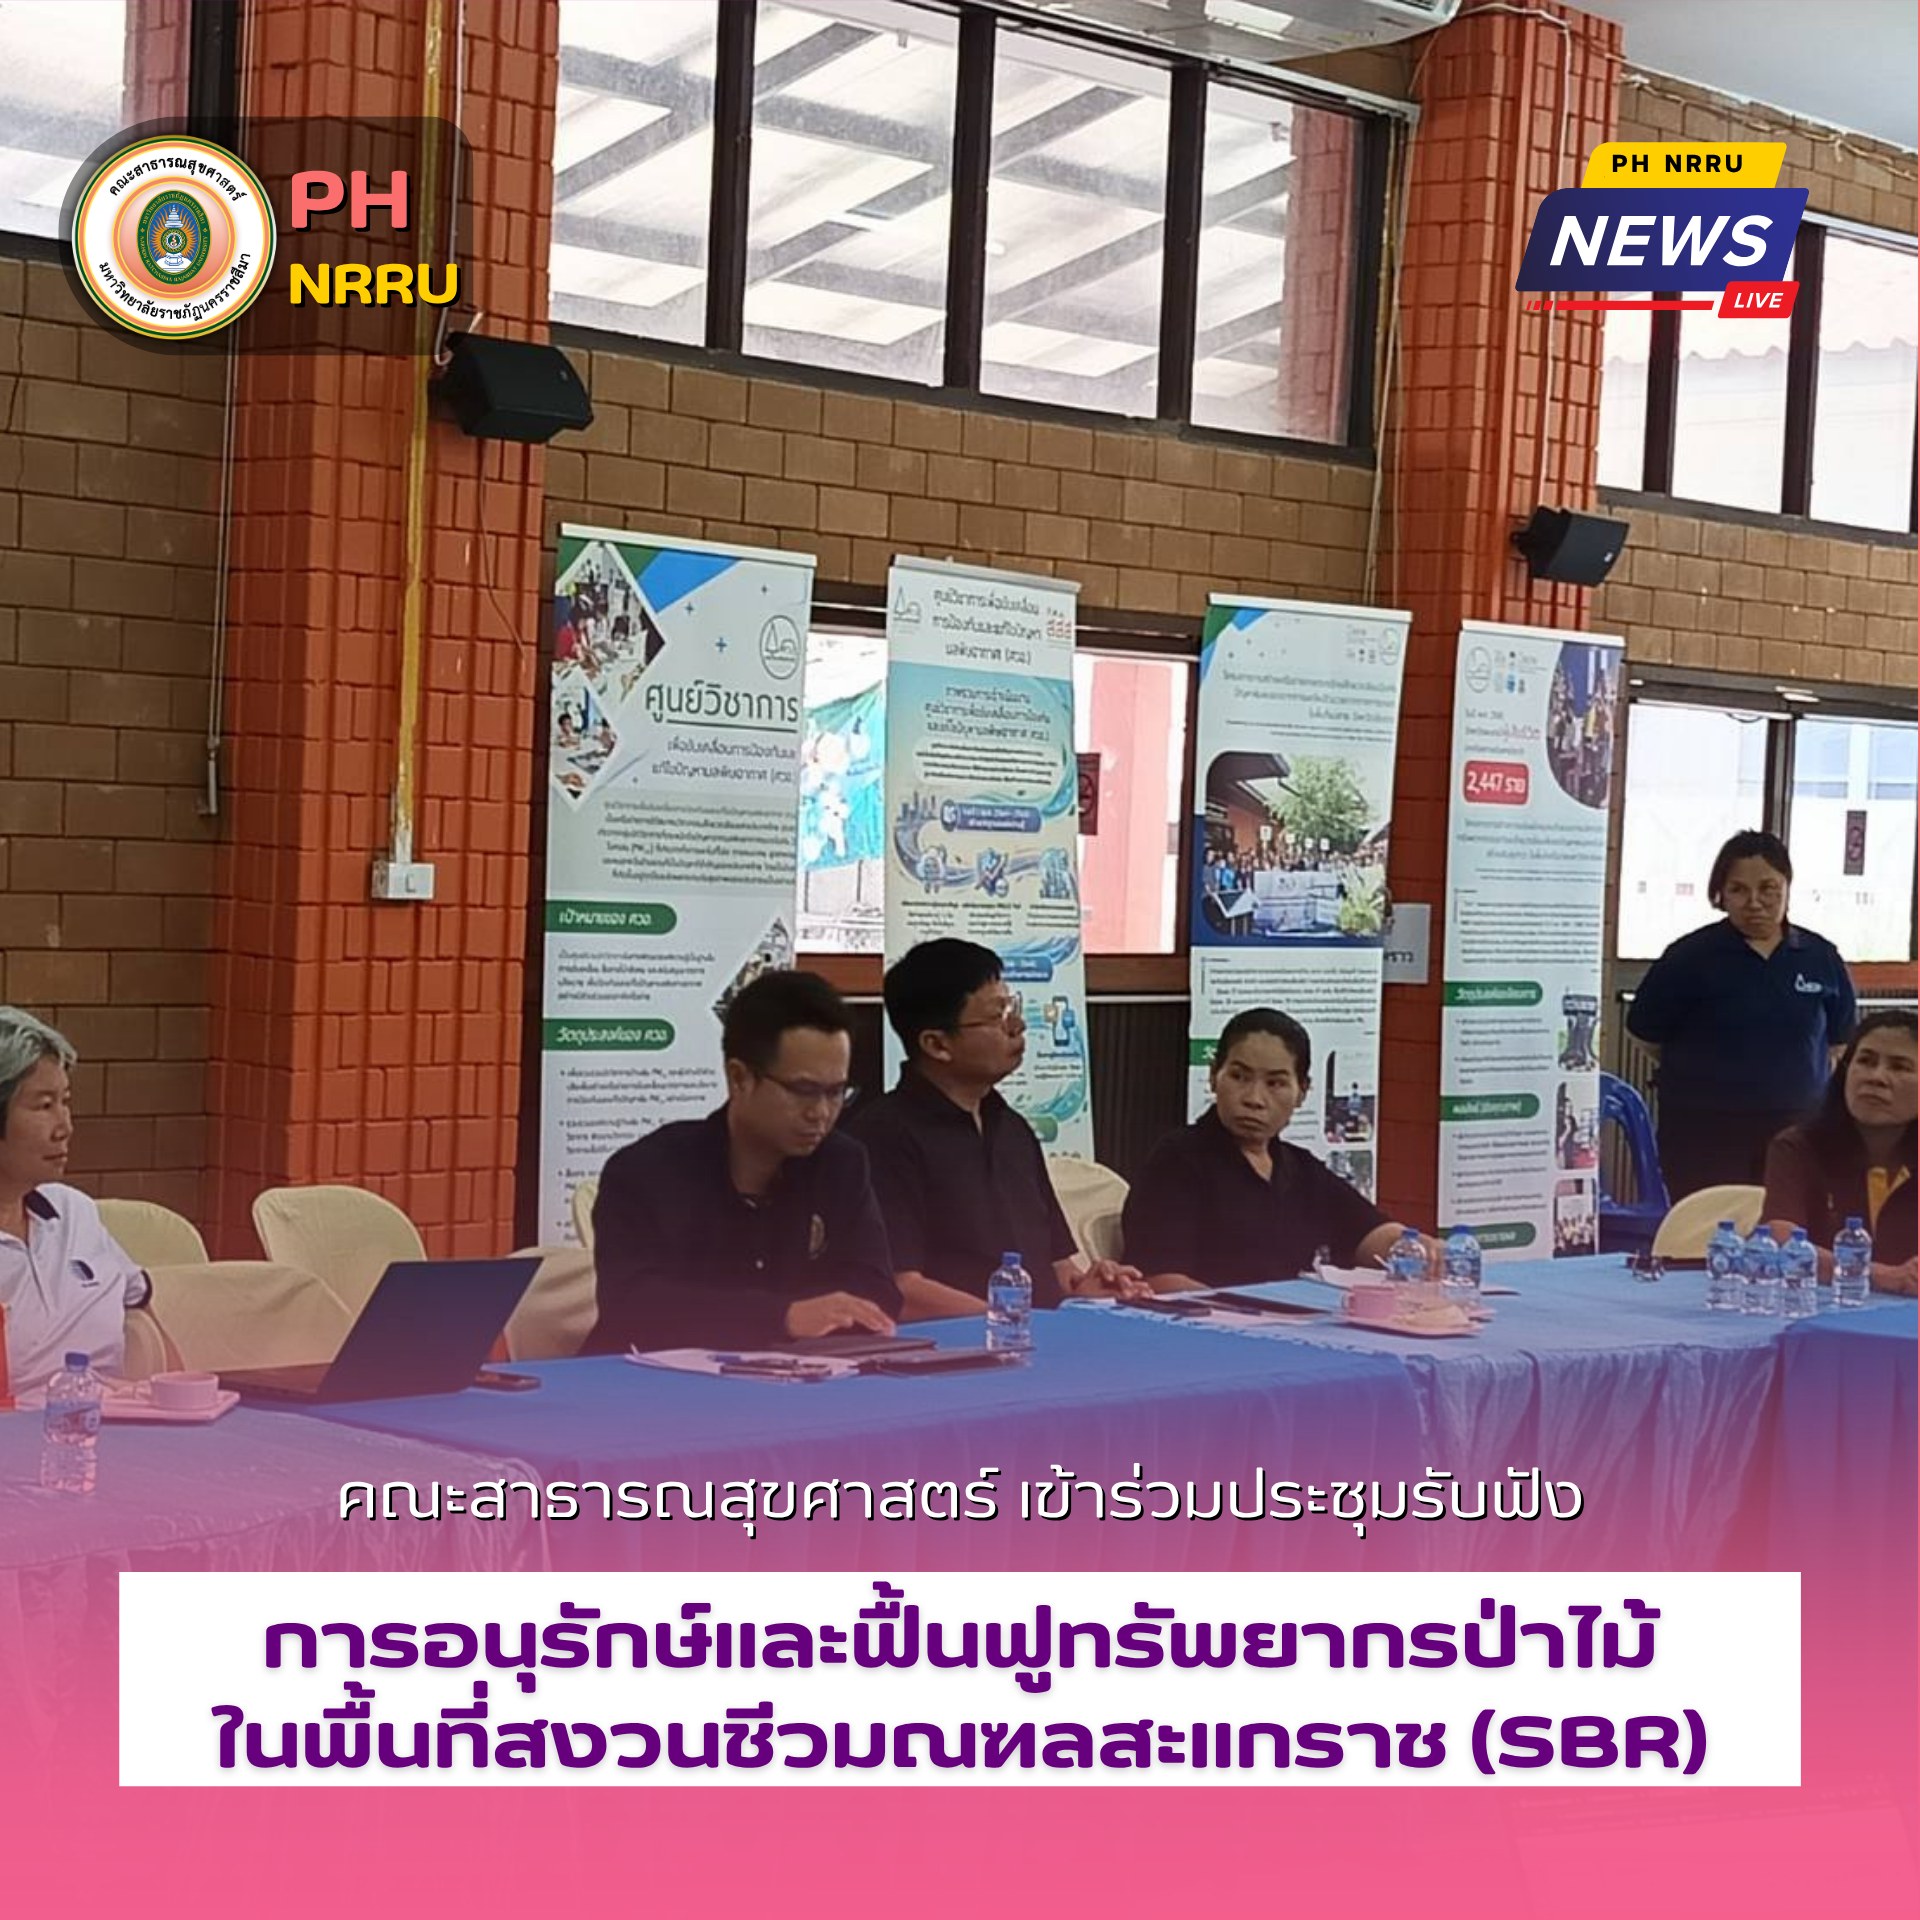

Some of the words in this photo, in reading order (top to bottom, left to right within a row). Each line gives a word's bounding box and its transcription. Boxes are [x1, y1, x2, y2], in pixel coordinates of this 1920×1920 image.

[645, 679, 799, 723] ศูนย์วิชาการ
[1466, 771, 1504, 794] 2,447
[558, 908, 626, 926] เป้าหมายของ
